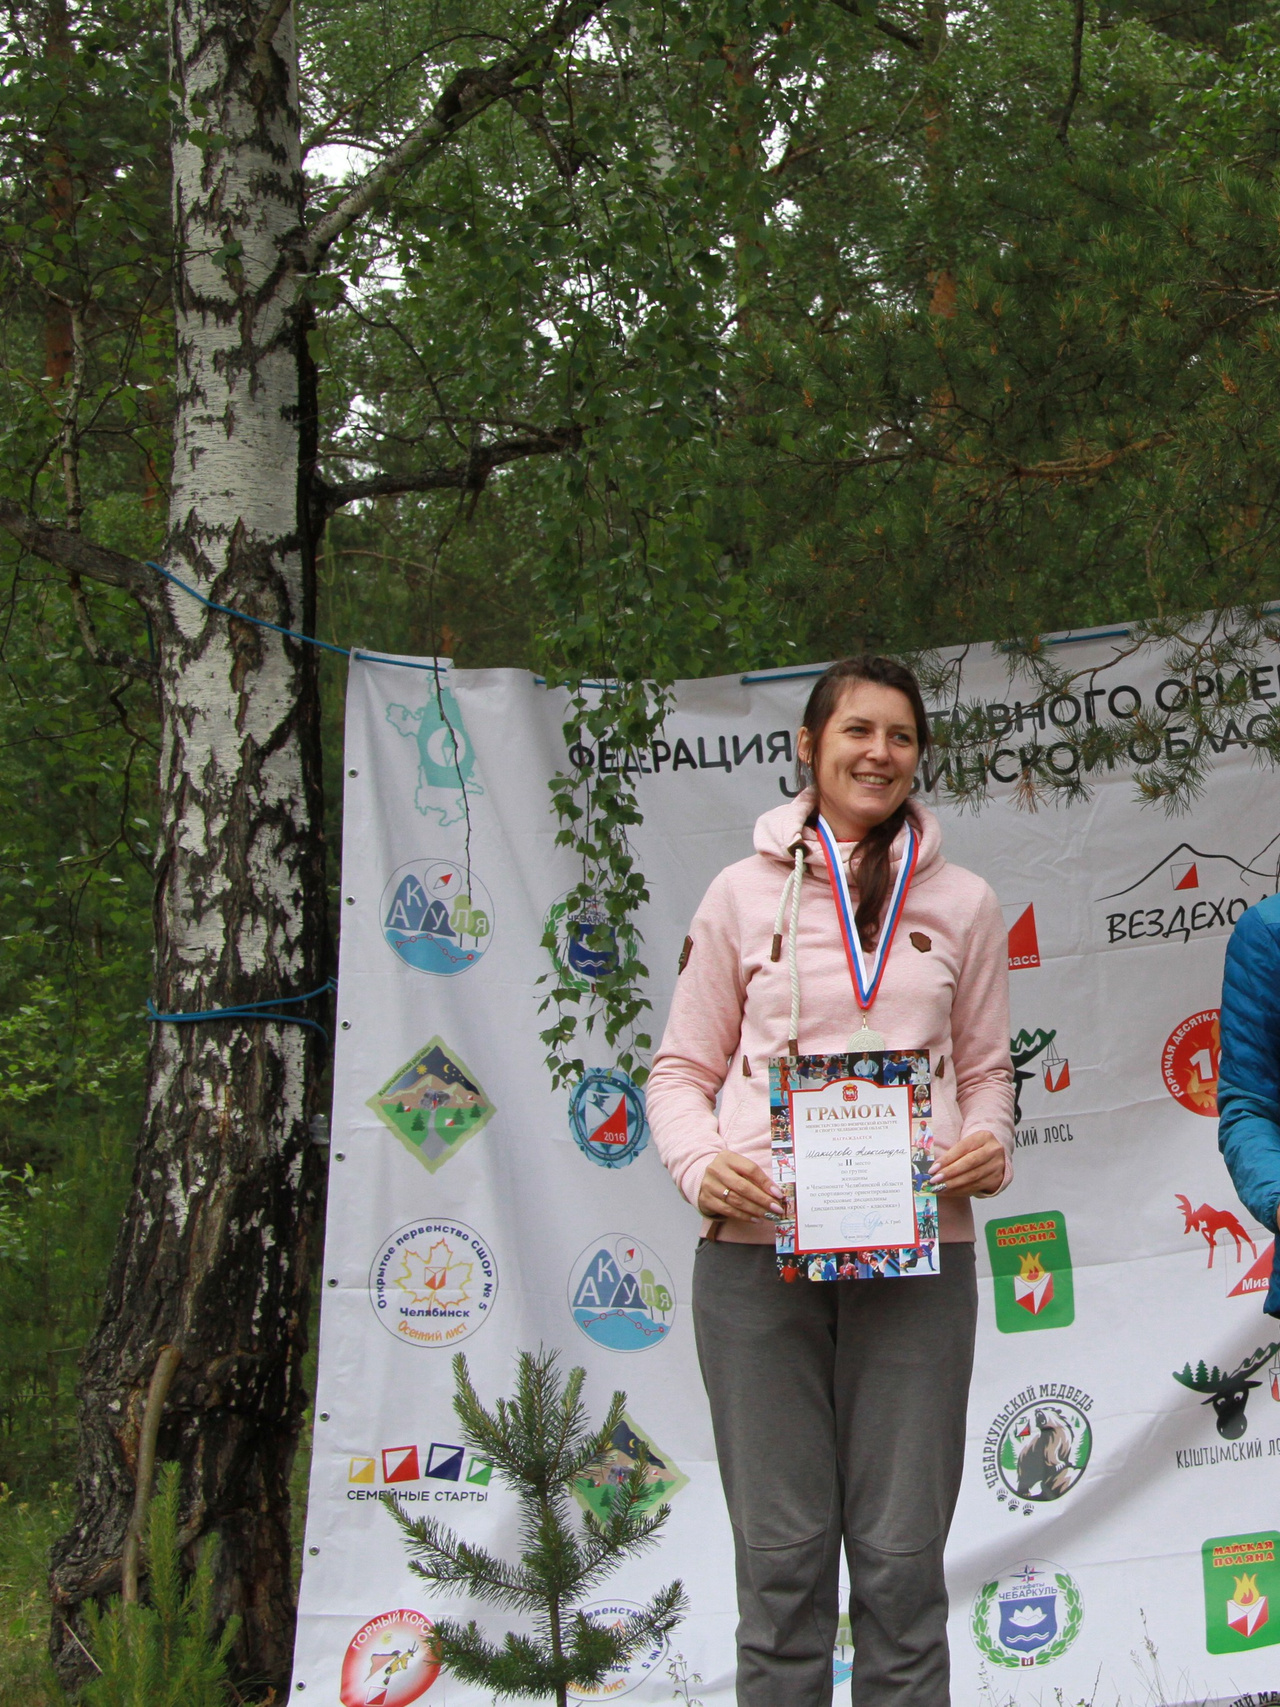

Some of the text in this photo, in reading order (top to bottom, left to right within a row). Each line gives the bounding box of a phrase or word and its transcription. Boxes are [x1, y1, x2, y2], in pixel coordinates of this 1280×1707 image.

[1106, 894, 1266, 944] ВЕЗДЕХО
[1164, 1012, 1219, 1098] ГОРЯЧАЯ ДЕСЯТКА
[805, 1104, 897, 1121] ГРАМОТА
[603, 1131, 626, 1143] 2016
[1043, 1124, 1074, 1144] ЛОСЬ
[996, 1220, 1056, 1237] МАЙСКАЯ
[997, 1231, 1057, 1248] ПОЛЯНА
[376, 1224, 493, 1311] Открытое первенство СШОР № 5
[400, 1307, 470, 1318] Челябинск
[397, 1320, 442, 1341] Осенний
[982, 1383, 1094, 1489] ЧЕБАРКУЛЬСКИЙ МЕДВЕДЬ
[1176, 1438, 1263, 1469] КЫШТЫМСКИЙ
[434, 1491, 488, 1501] СТАРТЫ
[1212, 1540, 1274, 1556] МАЙСКАЯ
[1213, 1552, 1275, 1568] ПОЛЯНА
[999, 1586, 1058, 1600] ЧЕБАРКУЛЬ
[352, 1609, 434, 1650] ГОРНЫЙ КОРО
[641, 1661, 651, 1670] 5
